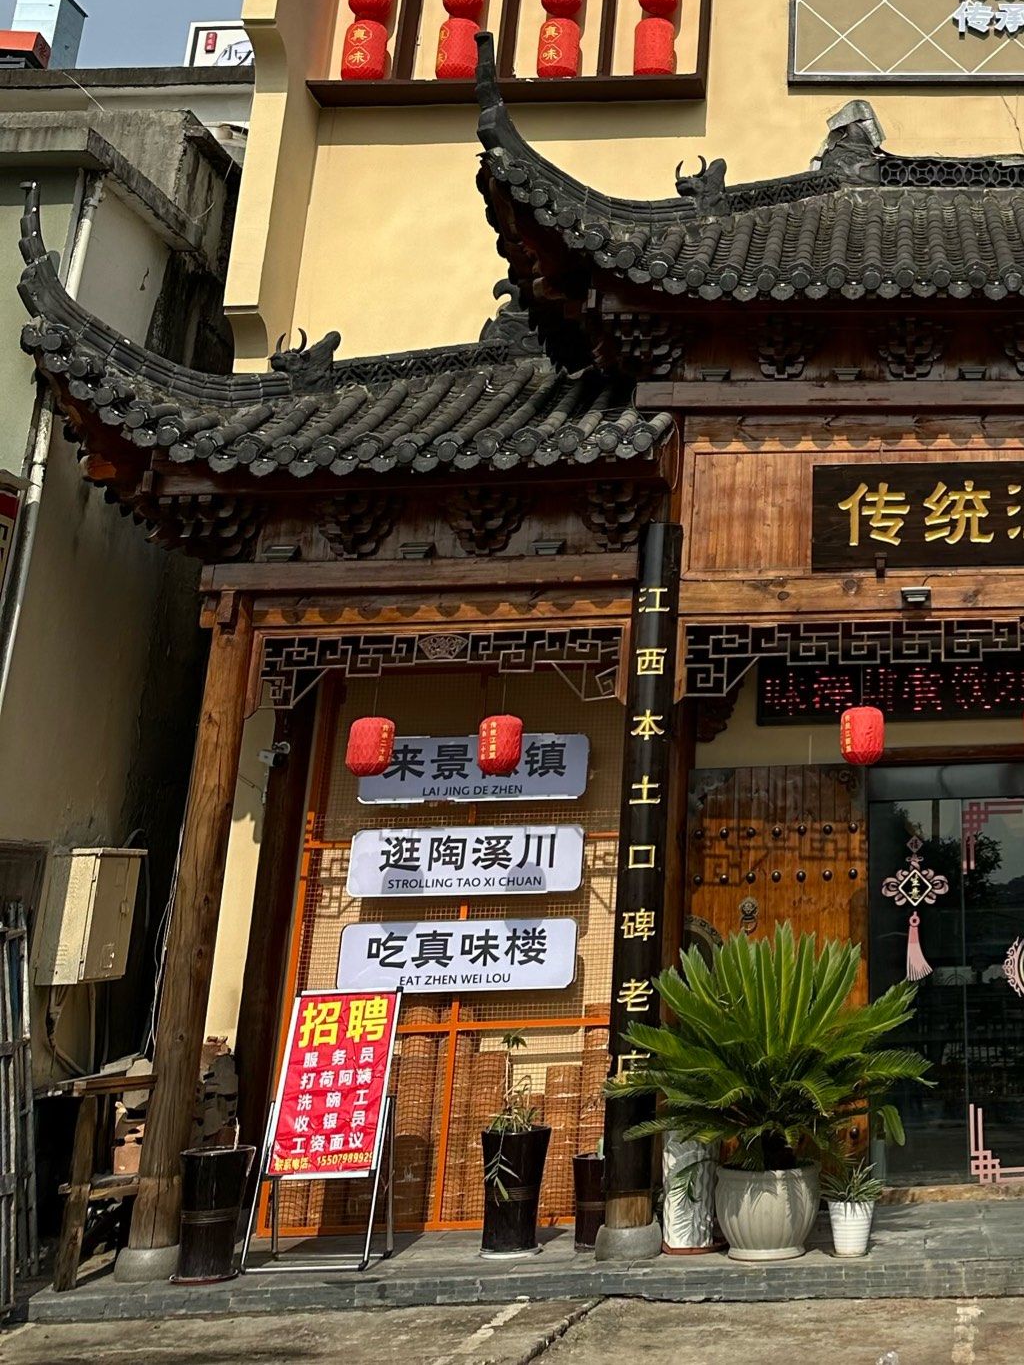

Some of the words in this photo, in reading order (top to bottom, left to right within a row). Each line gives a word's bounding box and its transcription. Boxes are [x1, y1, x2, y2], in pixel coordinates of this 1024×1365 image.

[349, 29, 367, 63] 真味
[543, 23, 559, 61] 真味
[382, 740, 567, 780] 来景镇
[422, 786, 440, 797] LAI
[445, 786, 470, 797] JING
[473, 785, 489, 795] DE
[491, 784, 523, 795] ZHEN
[378, 833, 556, 872] 逛陶溪川
[388, 878, 453, 889] STROLLING
[456, 877, 481, 888] TAO
[484, 877, 495, 887] XI
[498, 876, 542, 887] CHUAN
[367, 927, 547, 969] 吃真味楼
[399, 975, 421, 986] EAT
[424, 975, 457, 985] ZHEN
[461, 974, 482, 984] WEI
[486, 973, 511, 984] LOU
[298, 996, 388, 1048] 招聘
[303, 1047, 374, 1068] 服务员
[297, 1090, 369, 1111] 洗碗工
[294, 1111, 365, 1133] 收银员
[291, 1133, 363, 1154] 工资面议
